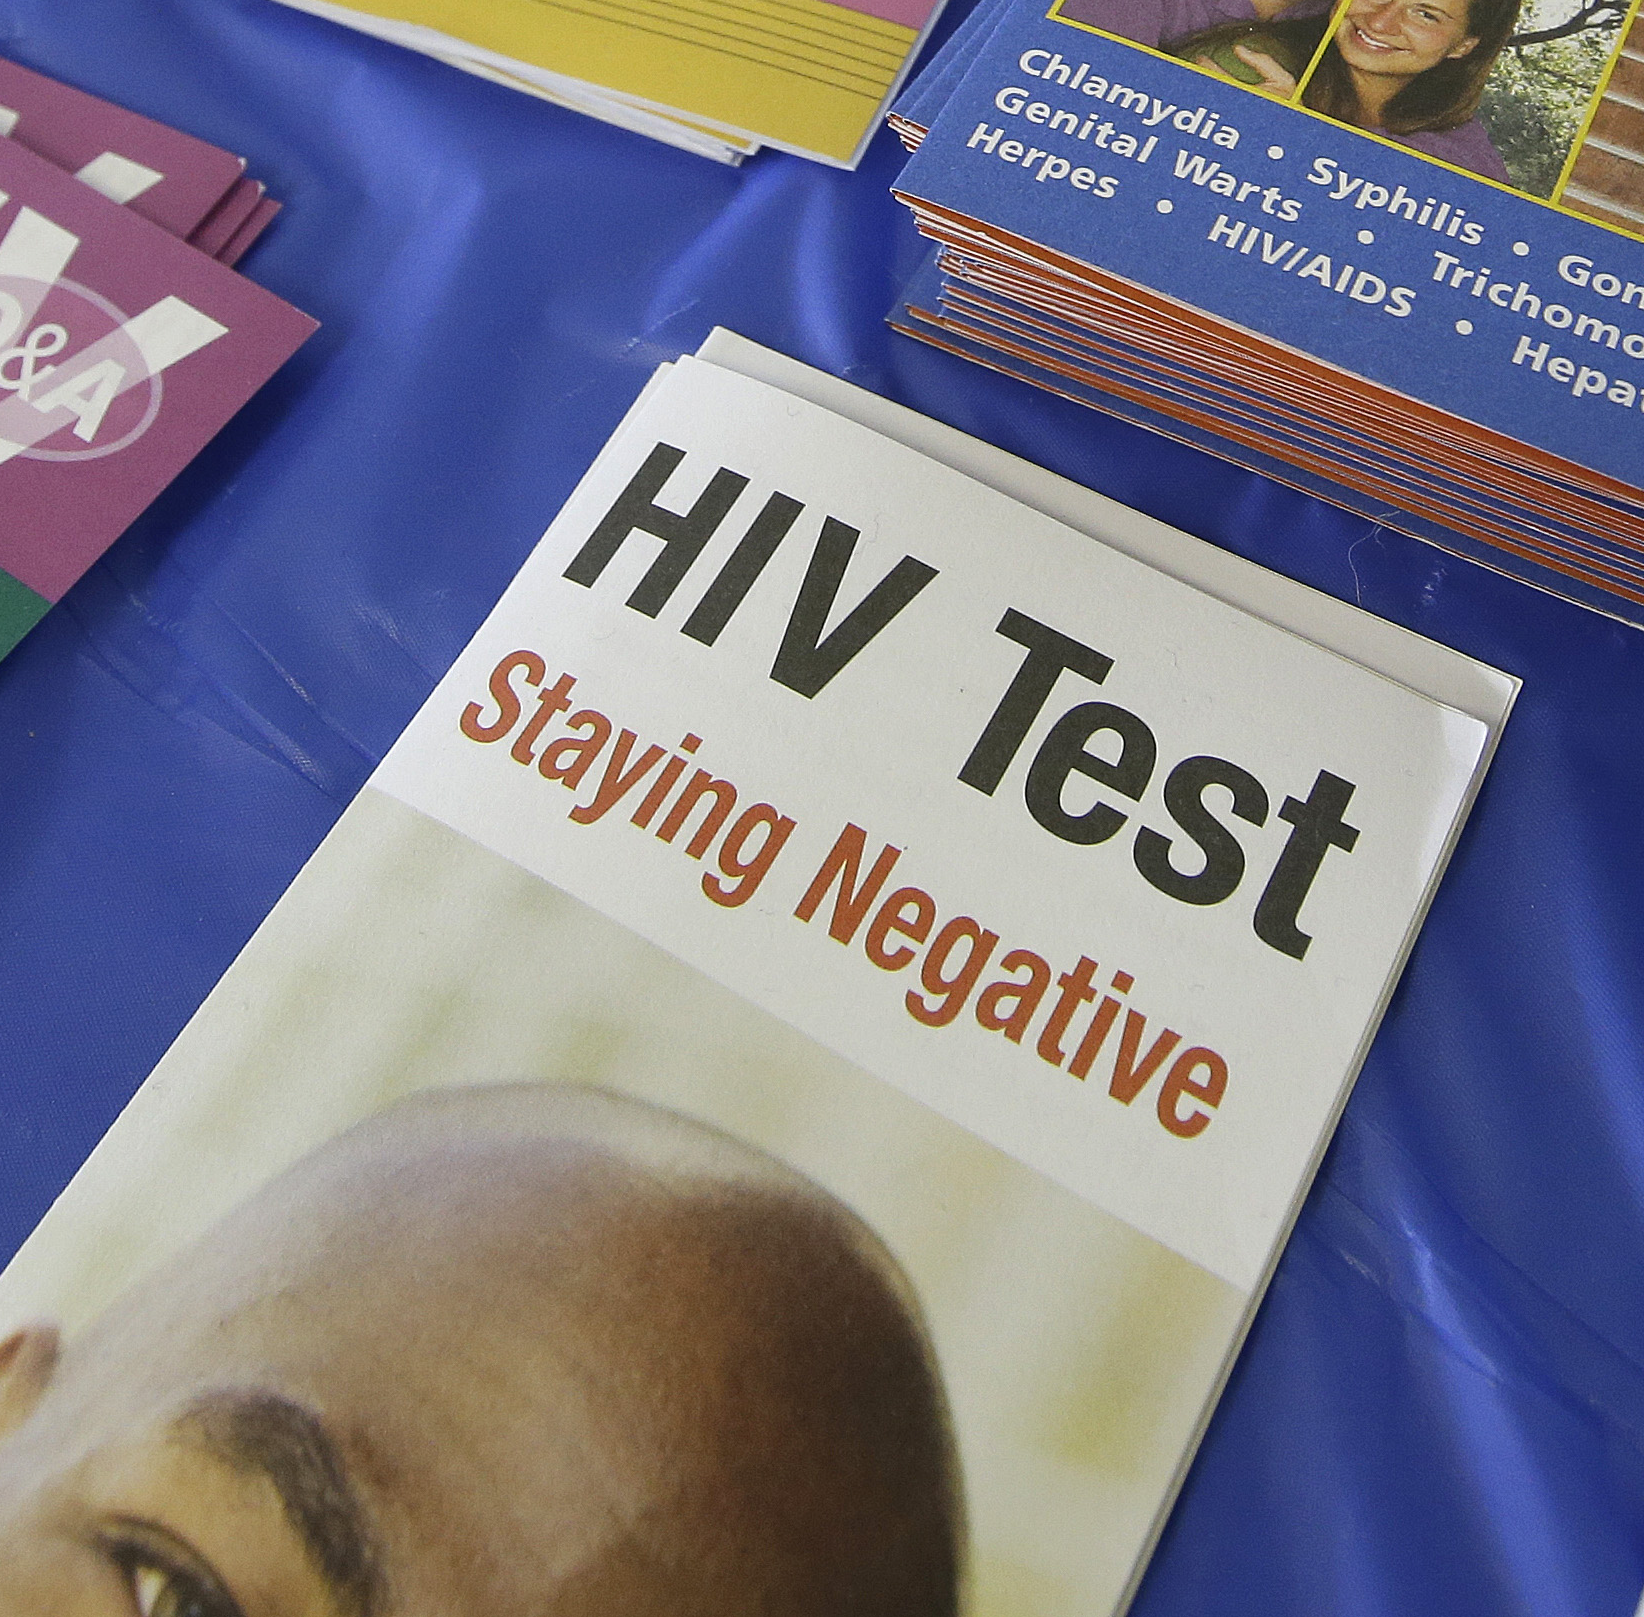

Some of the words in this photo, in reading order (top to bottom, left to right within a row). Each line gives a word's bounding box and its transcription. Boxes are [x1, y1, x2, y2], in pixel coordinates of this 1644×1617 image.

[966, 122, 1120, 201] Herpes
[1208, 214, 1418, 320] HIV/AIDS
[993, 86, 1159, 165] Genital
[1172, 150, 1302, 224] Warts
[1018, 48, 1241, 150] Chlamydia
[1306, 155, 1485, 246] Syphilis
[562, 441, 940, 700] HIV
[955, 606, 1361, 961] Test
[459, 648, 798, 909] Staying
[795, 822, 1230, 1141] Negative
